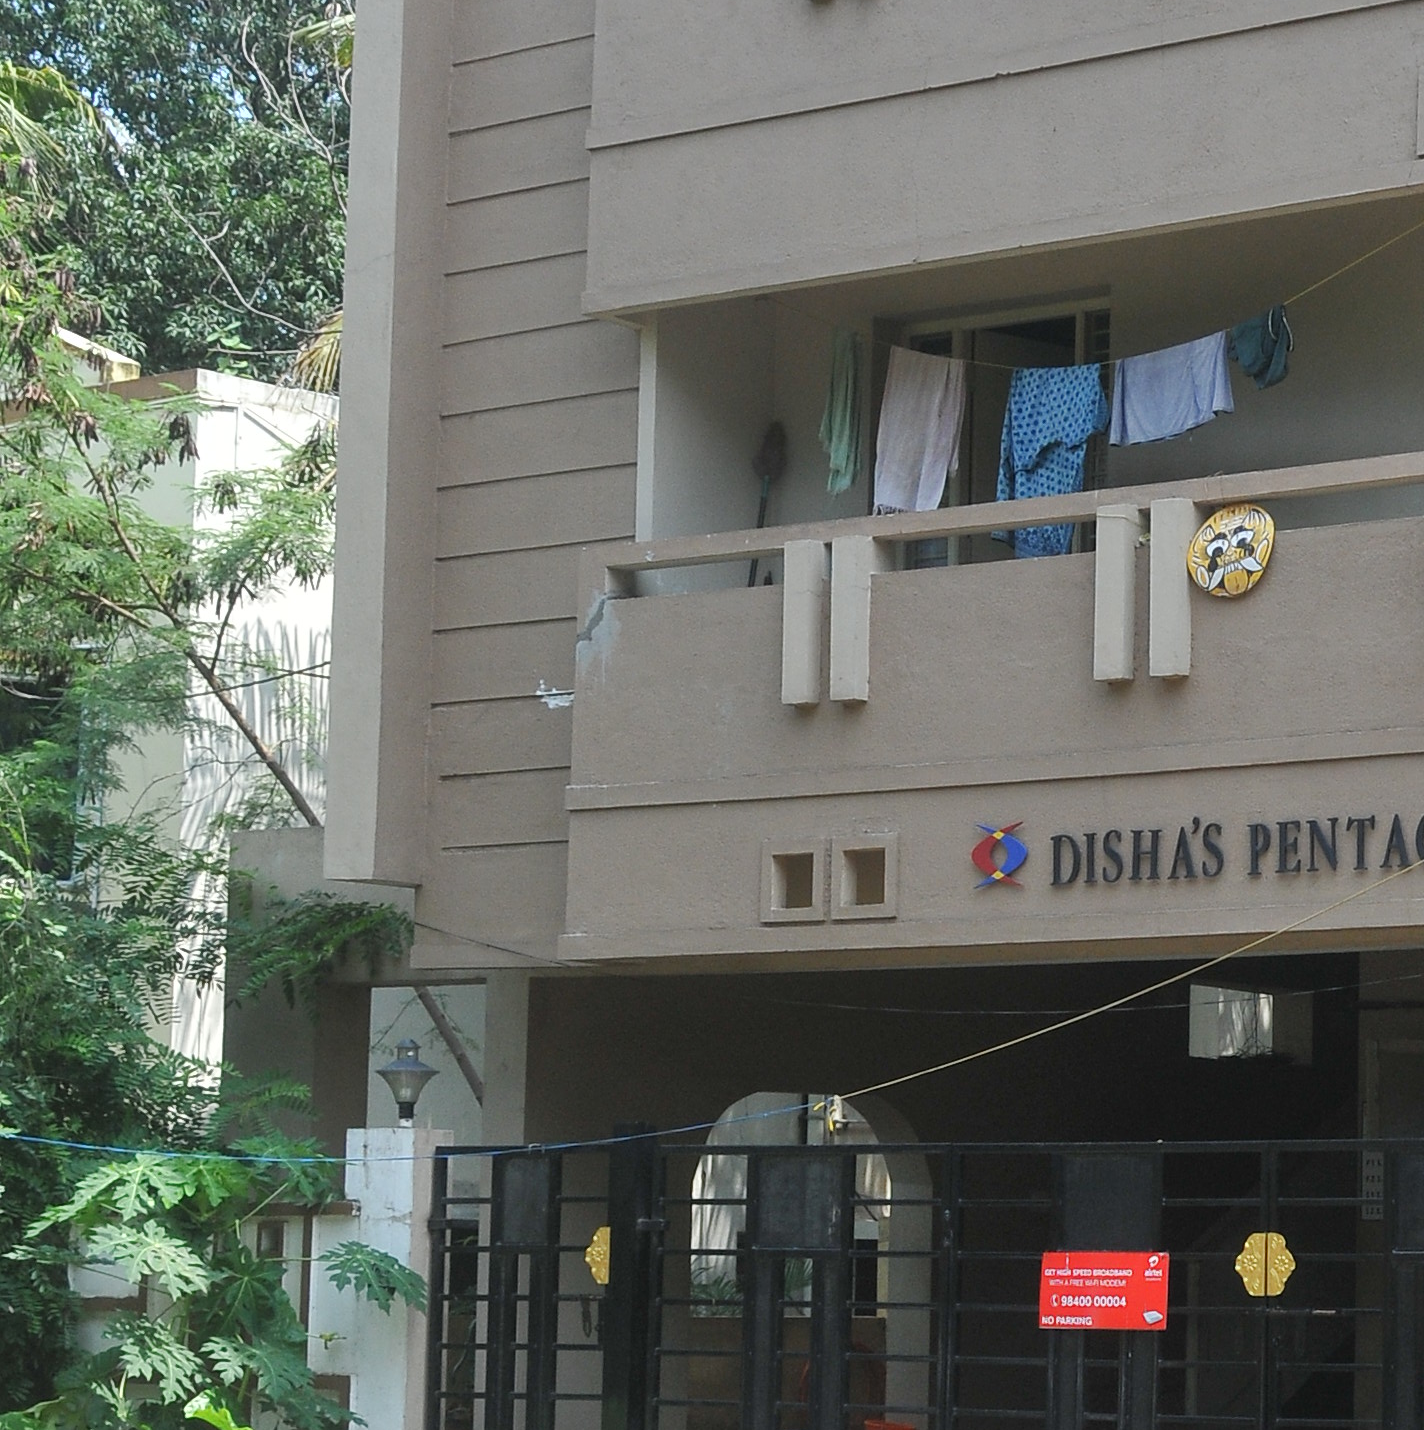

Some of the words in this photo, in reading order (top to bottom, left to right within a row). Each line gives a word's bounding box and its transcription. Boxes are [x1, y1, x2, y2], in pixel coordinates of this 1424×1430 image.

[1050, 815, 1225, 886] DISHA'S
[1061, 1295, 1092, 1307] 98400
[1094, 1295, 1127, 1308] 00004
[1041, 1316, 1053, 1325] NO
[1056, 1316, 1093, 1326] PARKING
